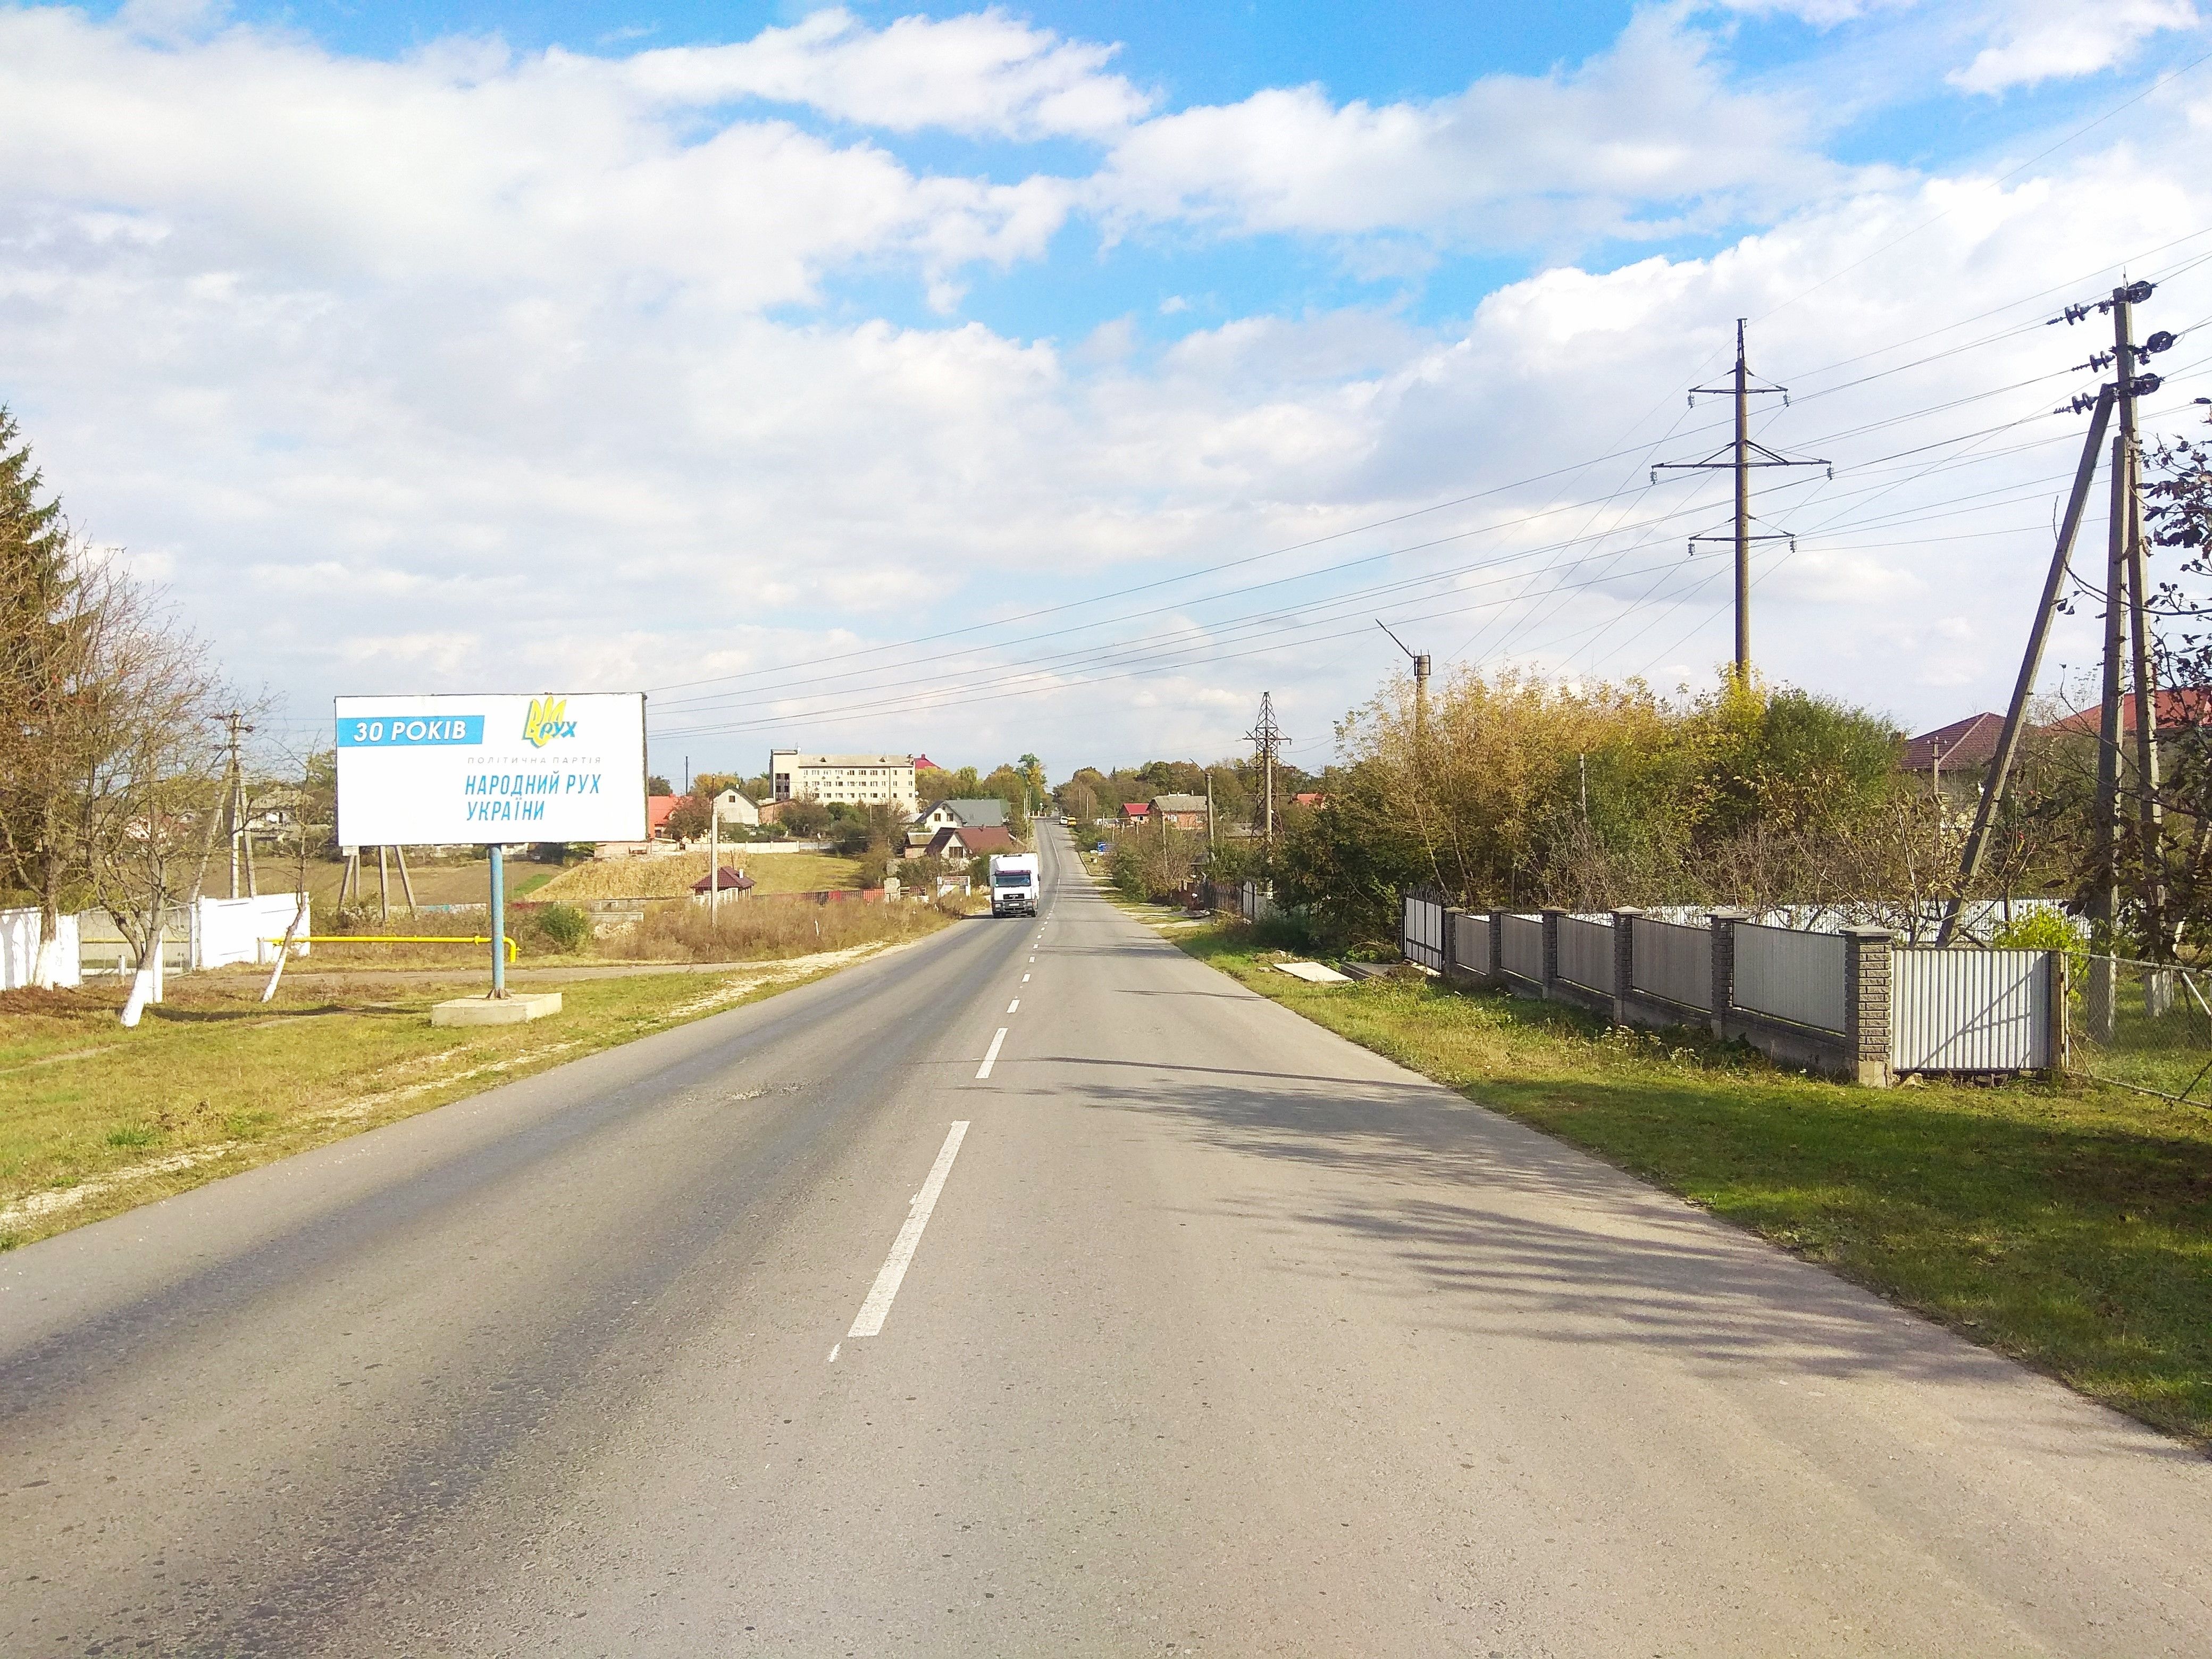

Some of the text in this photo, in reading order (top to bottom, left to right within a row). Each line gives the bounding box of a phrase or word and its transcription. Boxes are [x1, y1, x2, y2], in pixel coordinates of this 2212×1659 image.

[354, 720, 466, 742] 30 РОКІВ
[465, 770, 601, 797] НАРОДНИЙ РУХ
[466, 797, 544, 820] УКРАЇНИ
